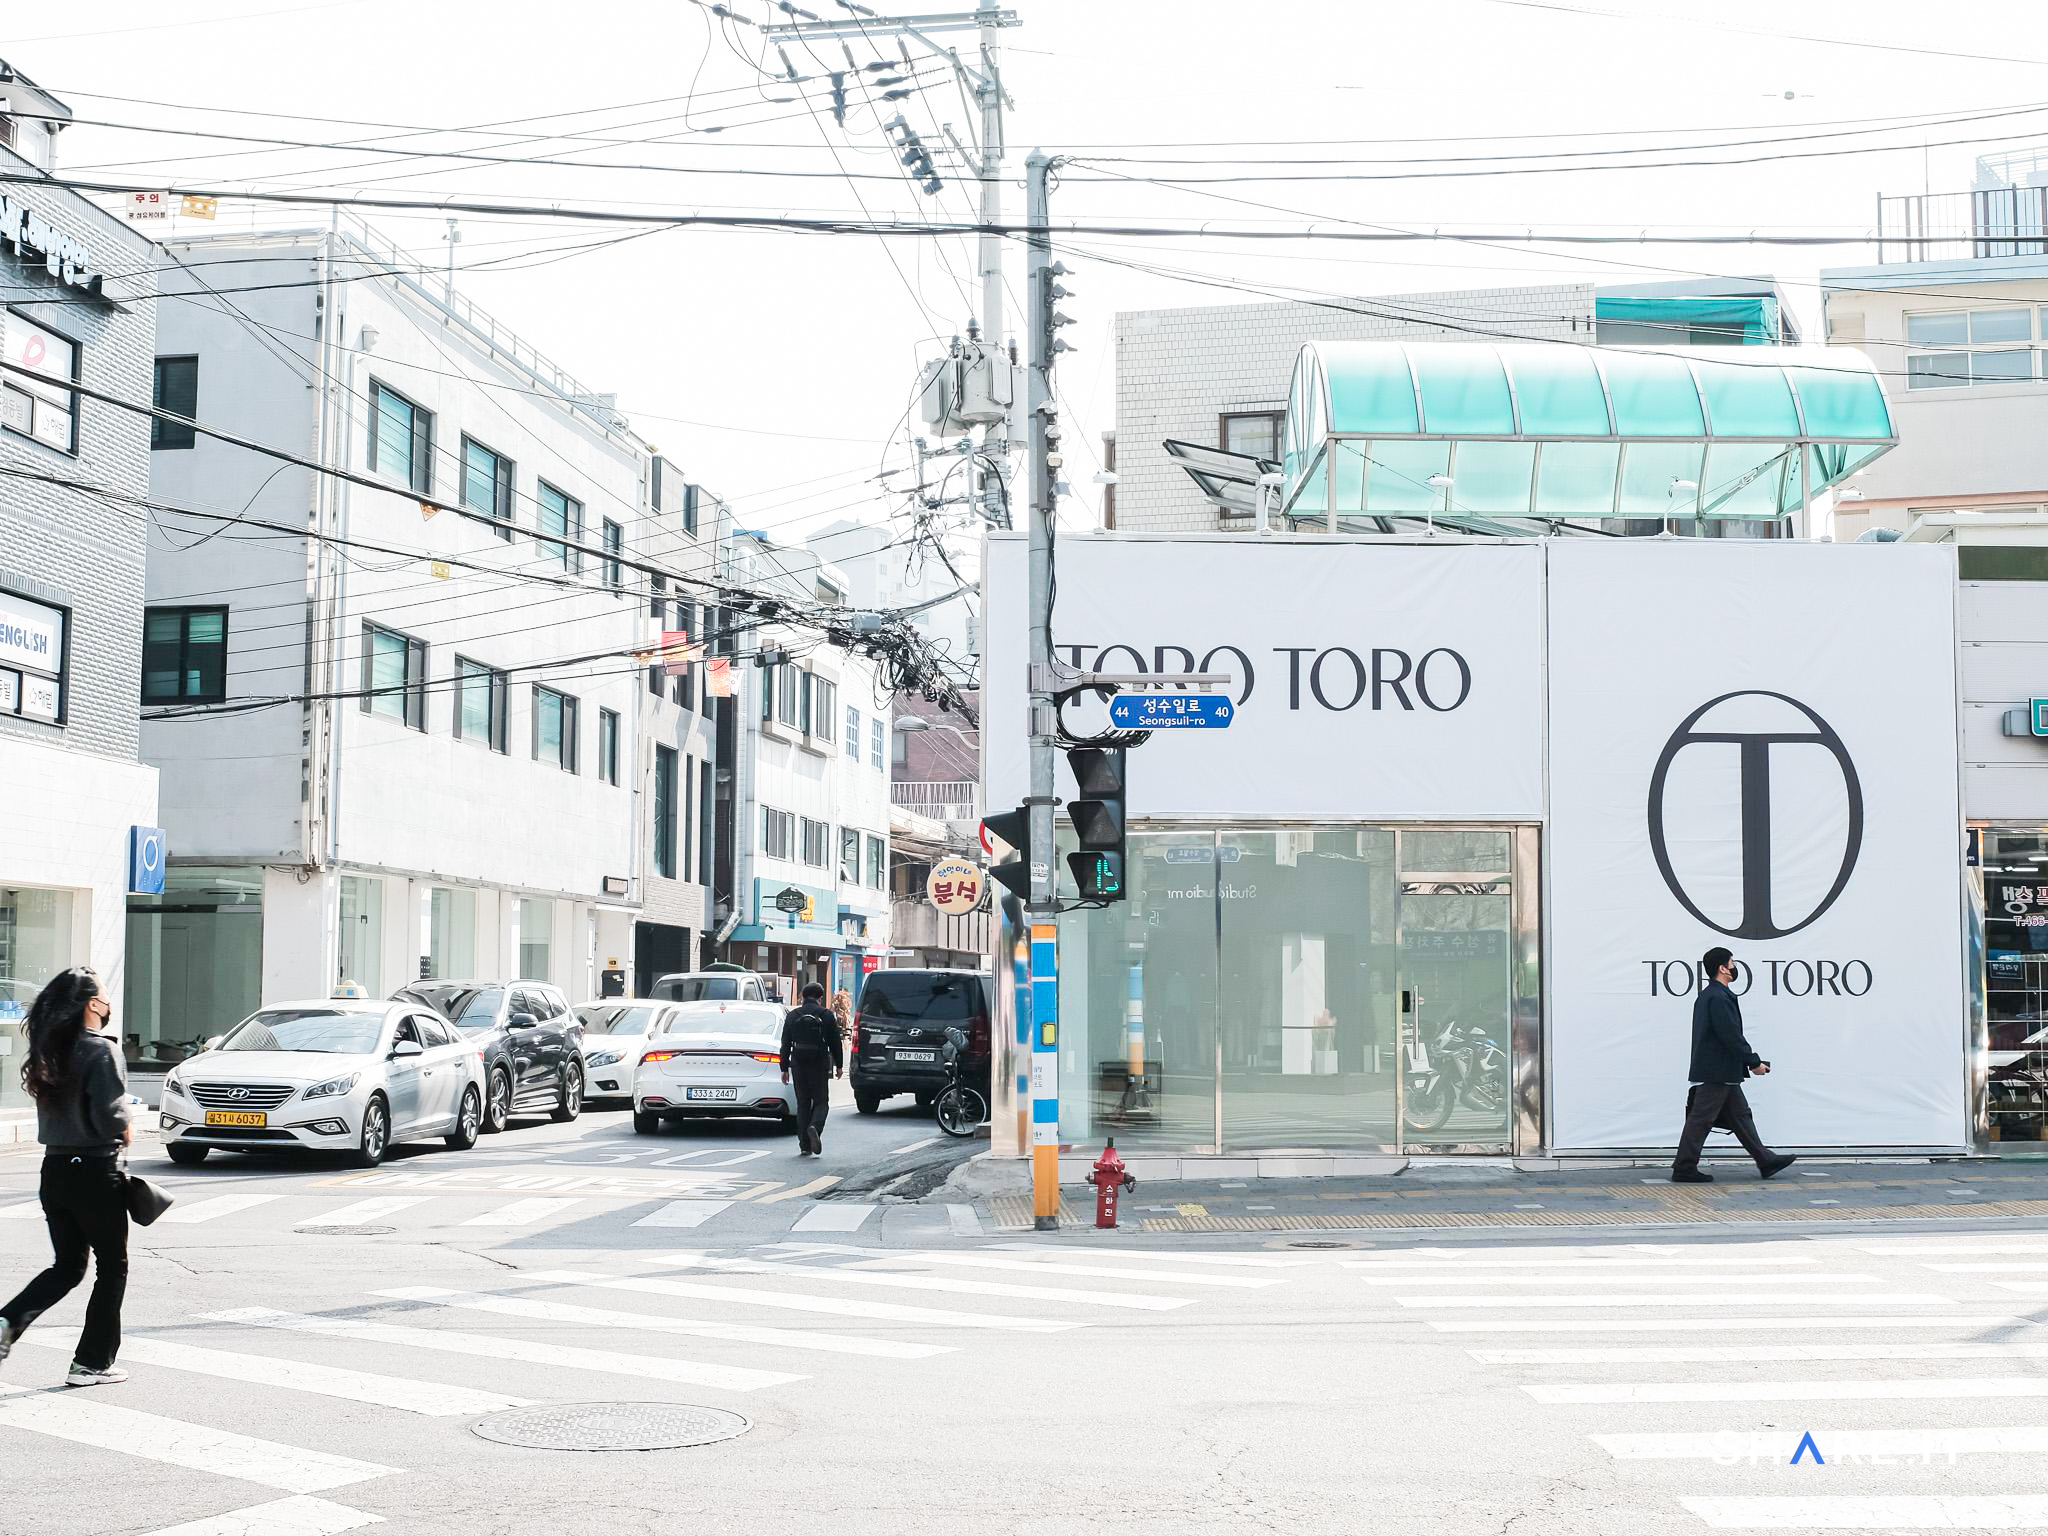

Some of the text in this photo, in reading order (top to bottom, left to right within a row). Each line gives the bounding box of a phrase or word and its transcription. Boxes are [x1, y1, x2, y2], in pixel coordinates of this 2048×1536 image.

[135, 193, 159, 203] 주의
[1273, 646, 1472, 712] TORO
[1115, 706, 1129, 717] 44
[1143, 698, 1202, 714] 성수일로
[1215, 706, 1229, 717] 40
[1138, 716, 1206, 726] Seongsuil-ro
[934, 880, 977, 905] 분식
[1762, 959, 1873, 997] TORO
[715, 1089, 735, 1098] 2447
[236, 1114, 262, 1124] 6037
